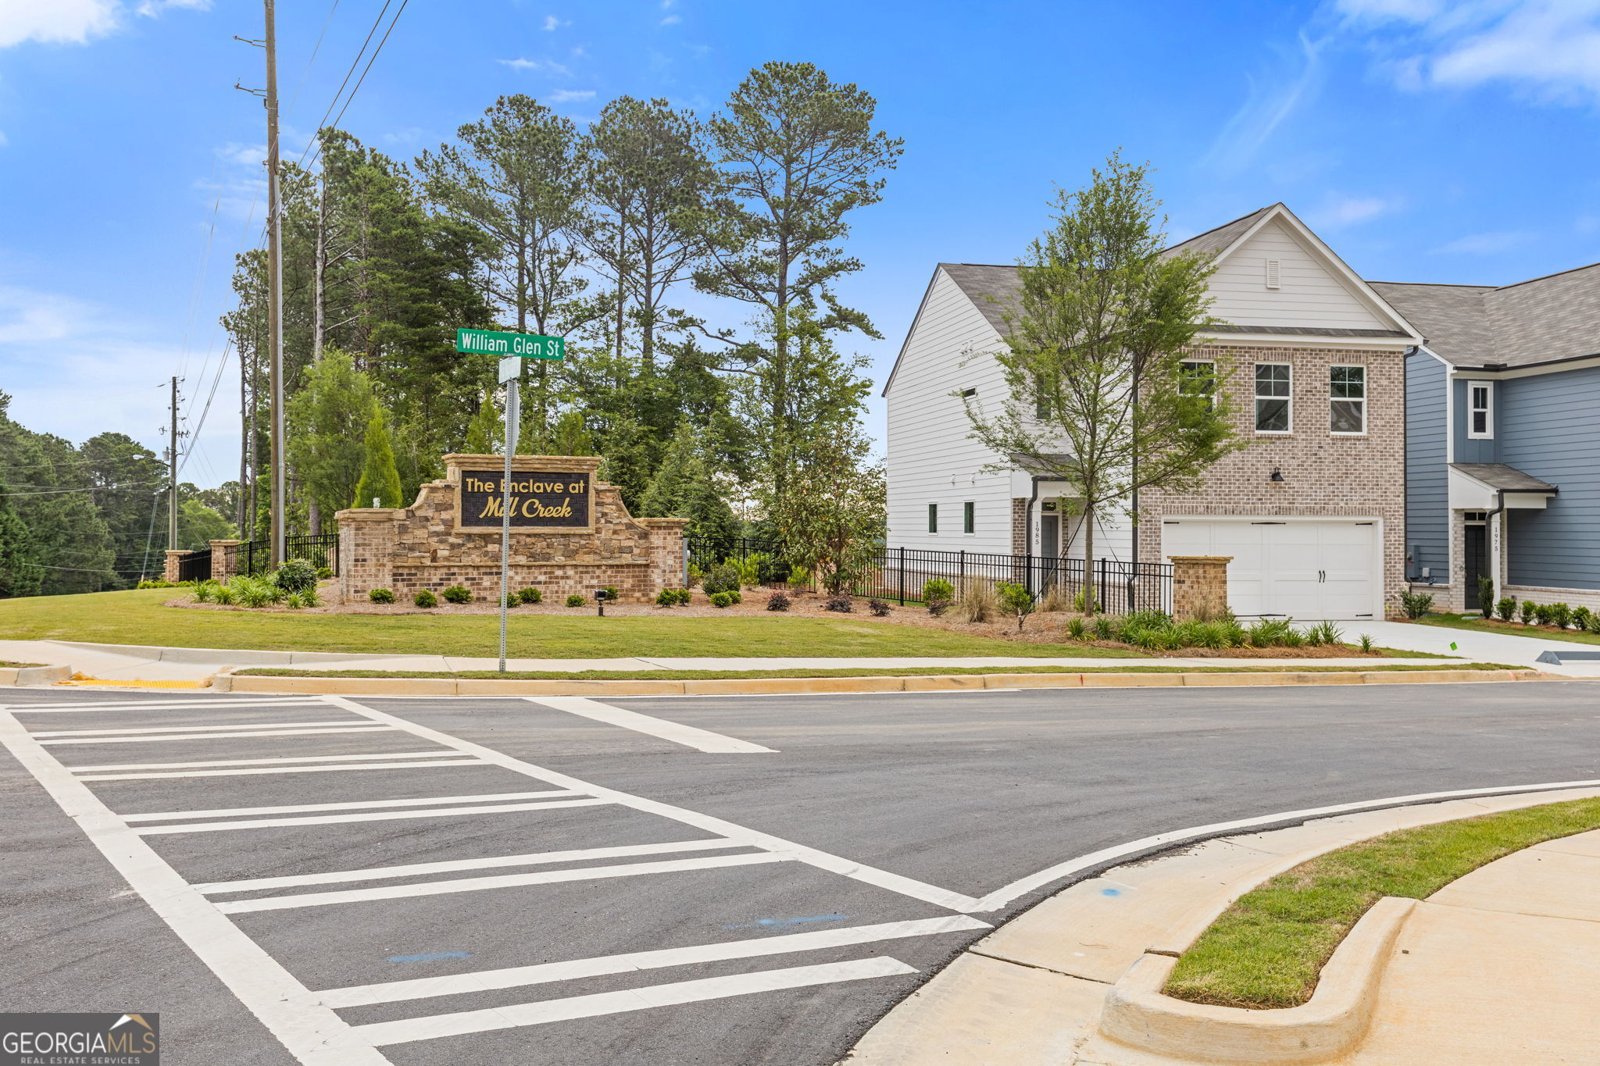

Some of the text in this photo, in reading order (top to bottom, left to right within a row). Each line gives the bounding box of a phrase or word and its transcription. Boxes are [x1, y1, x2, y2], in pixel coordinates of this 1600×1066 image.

[462, 332, 560, 357] William Glen St
[466, 478, 585, 494] The Enclave at
[521, 497, 573, 518] Creek
